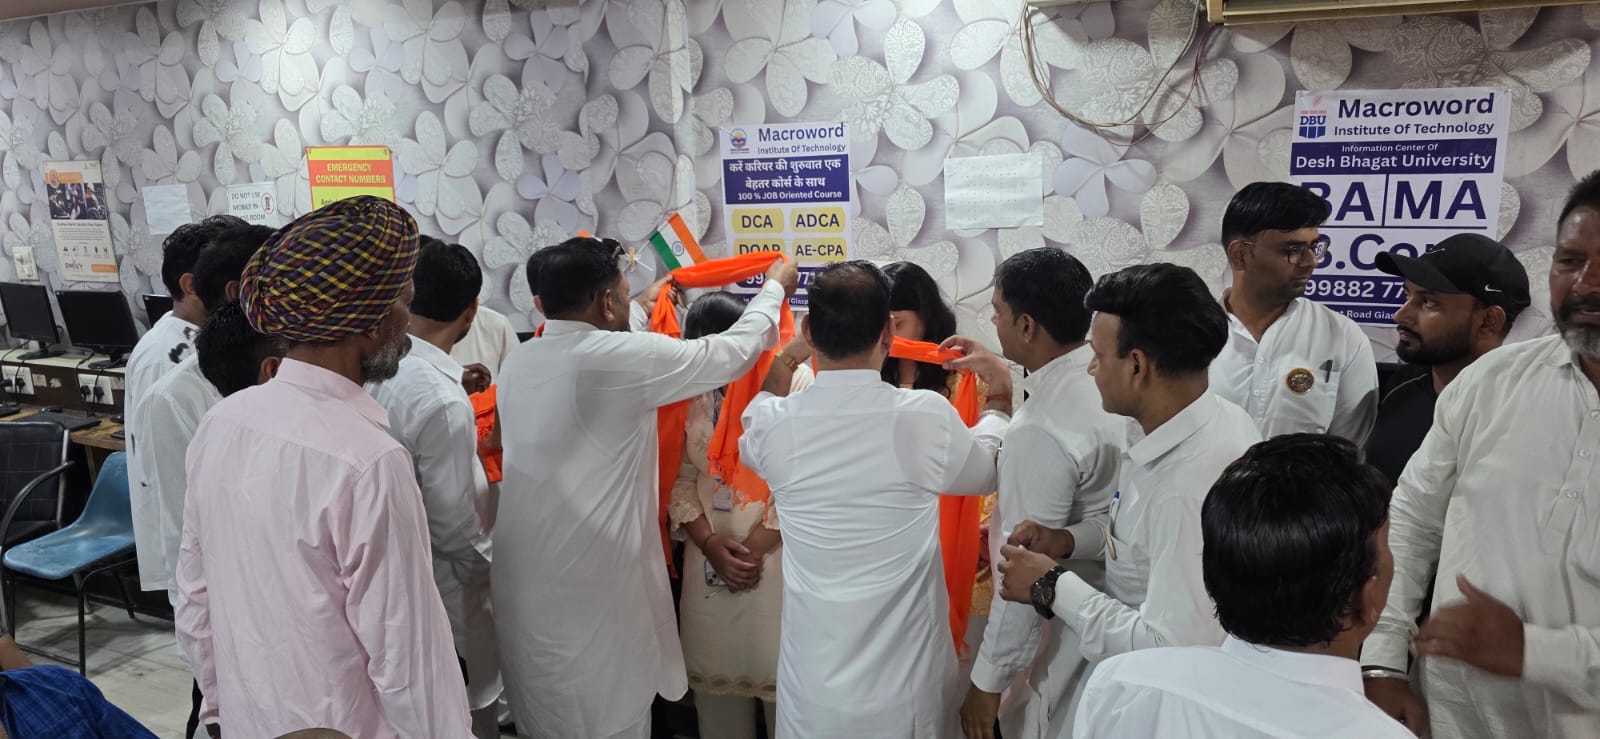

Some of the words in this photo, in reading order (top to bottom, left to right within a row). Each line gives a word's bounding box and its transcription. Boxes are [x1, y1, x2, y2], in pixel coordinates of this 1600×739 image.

[1338, 93, 1495, 119] Macroword
[1300, 115, 1327, 126] DBU
[758, 122, 844, 142] Macroword
[1334, 125, 1390, 136] Institute
[1394, 124, 1411, 134] Of
[1413, 122, 1495, 134] Technology
[758, 146, 790, 154] Institute
[791, 145, 801, 153] Of
[802, 143, 846, 153] Technology
[1342, 145, 1393, 153] Information
[1395, 144, 1424, 152] Center
[1427, 143, 1438, 151] Of
[327, 163, 372, 172] EMERGENCY
[745, 160, 773, 172] करियर
[775, 159, 788, 170] की
[824, 158, 841, 170] एक
[1296, 156, 1336, 168] Desh
[1340, 155, 1398, 170] Bhagat
[1402, 153, 1492, 168] University
[315, 175, 347, 184] CONTACT
[349, 175, 386, 184] NUMBERS
[794, 175, 804, 187] के
[805, 176, 826, 187] साथ
[738, 192, 753, 200] 100
[763, 191, 778, 199] JOB
[779, 190, 813, 199] Oriented
[814, 190, 842, 198] Course
[1394, 180, 1487, 220] MA
[741, 215, 773, 228] DCA
[795, 214, 840, 228] ADCA
[795, 244, 844, 256] AE-CPA
[1304, 280, 1375, 297] 99882
[1347, 310, 1372, 319] Road
[1374, 311, 1396, 320] Gias
